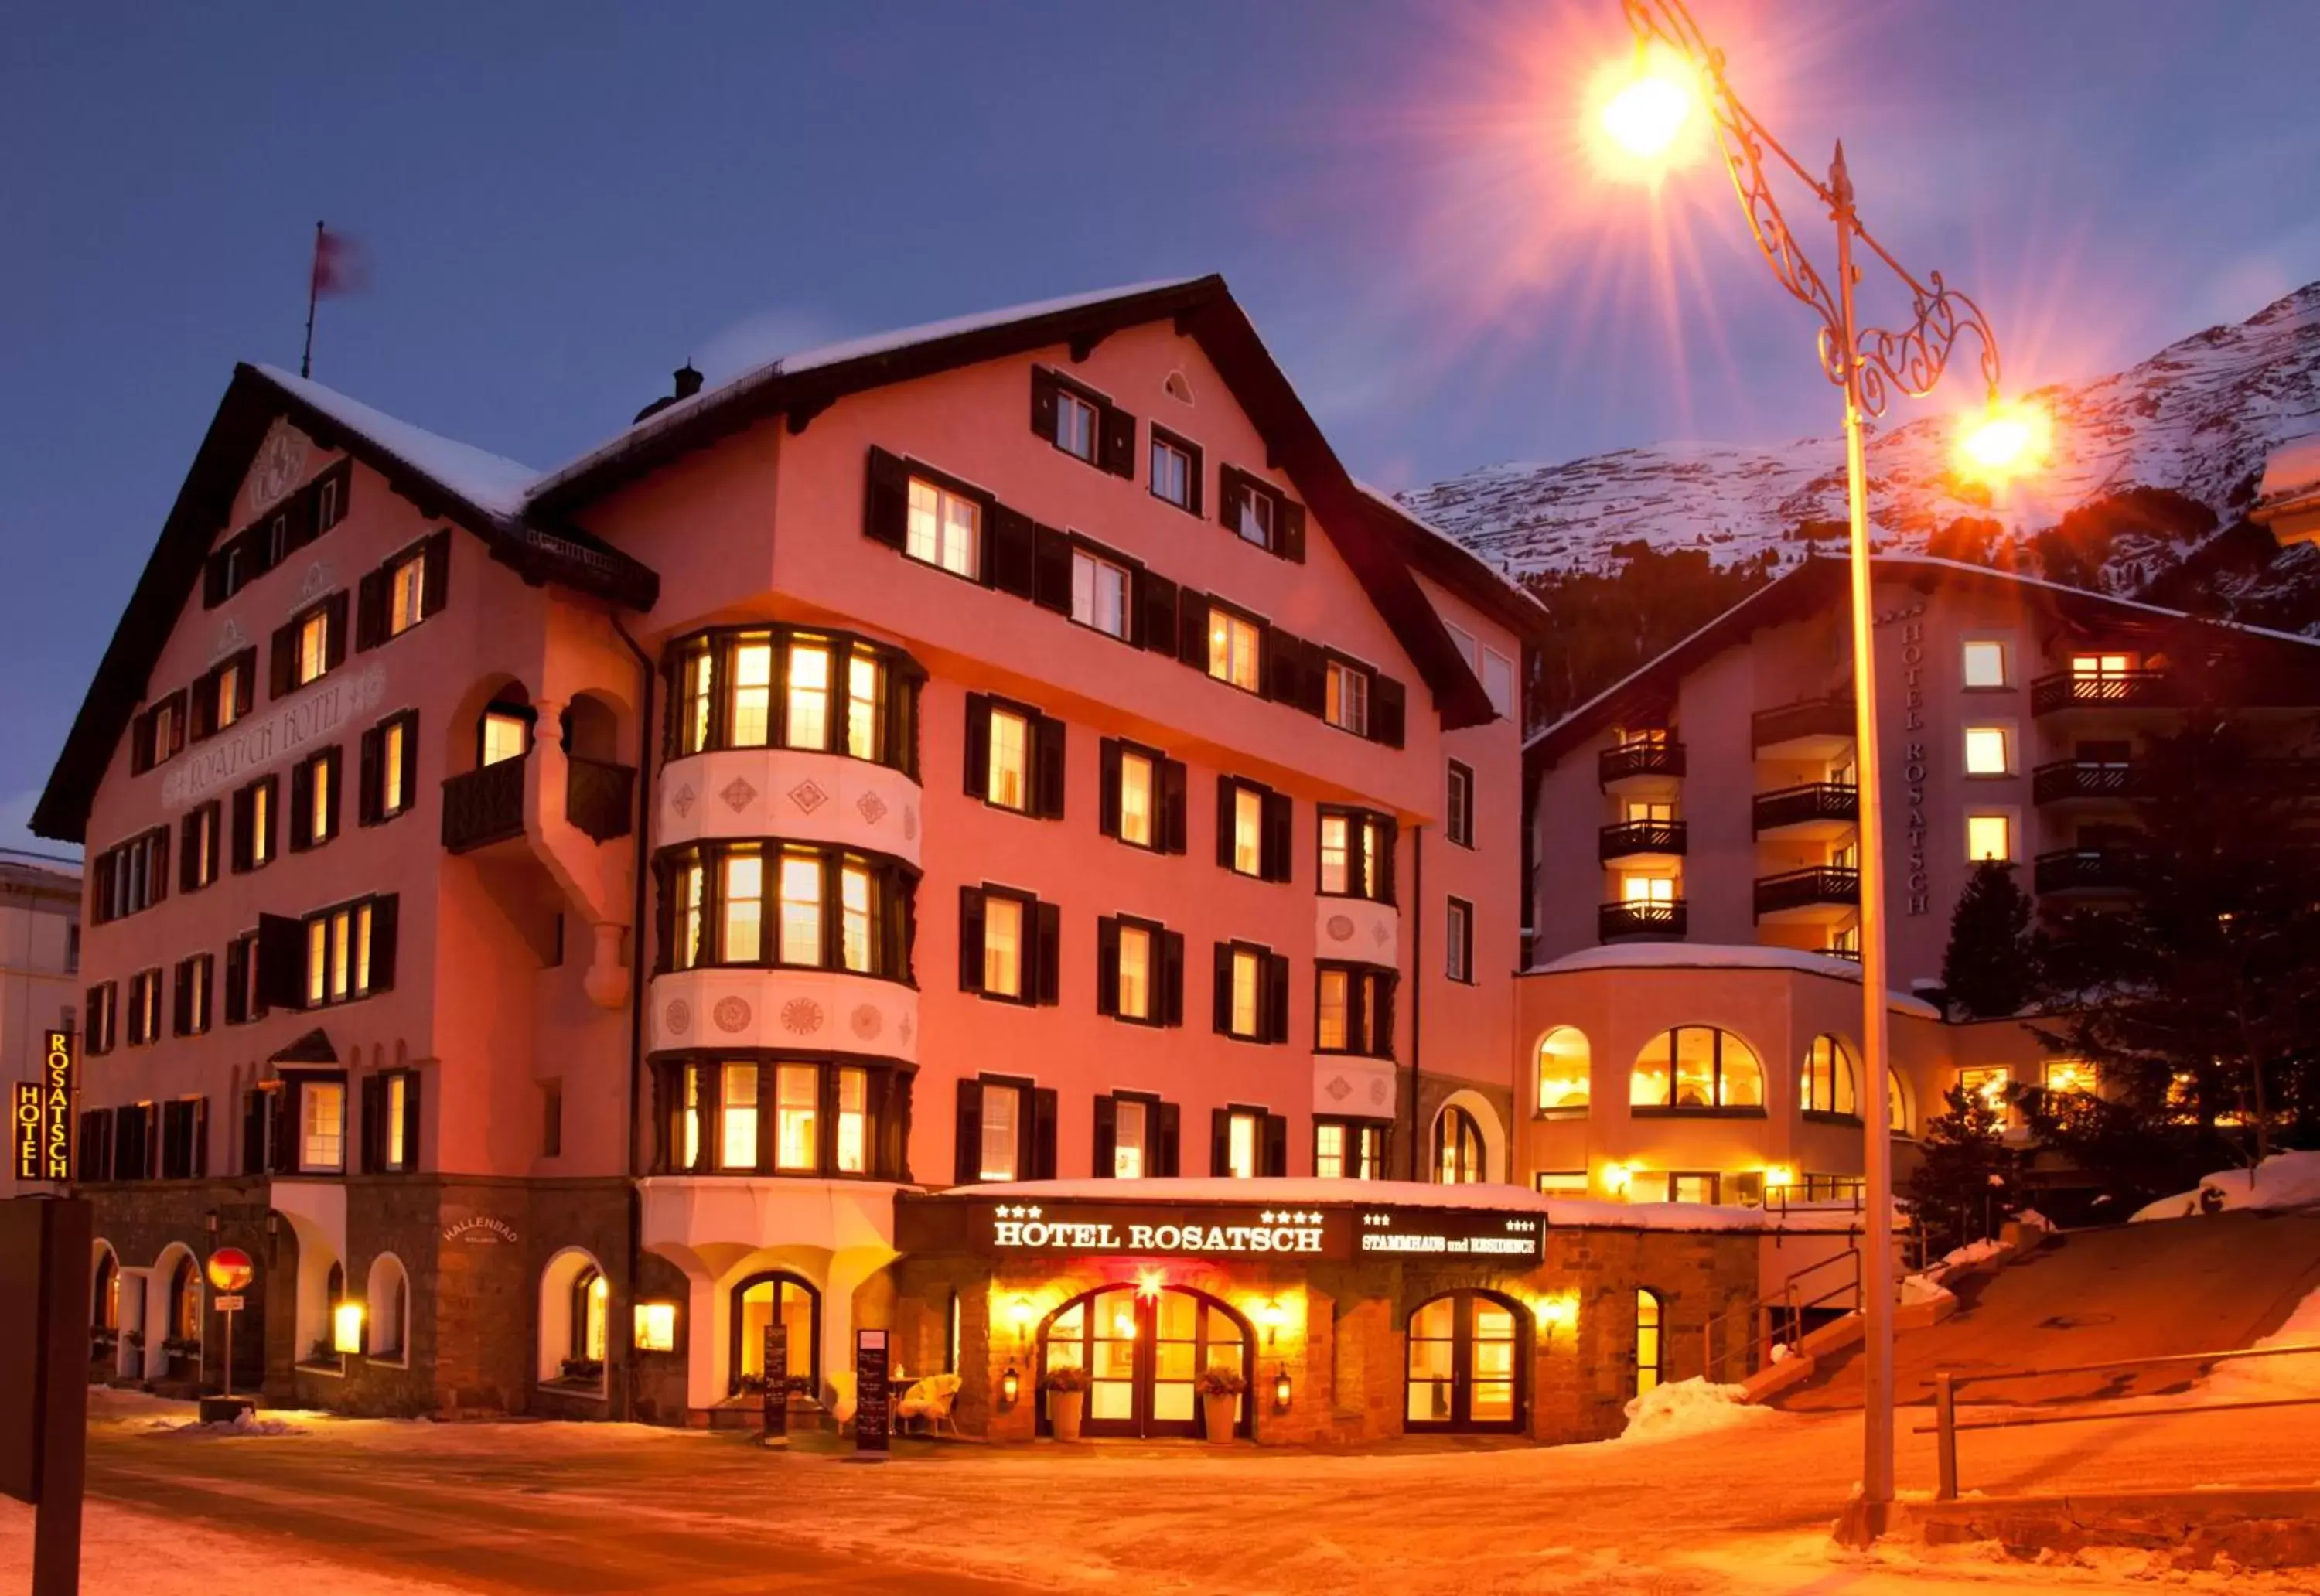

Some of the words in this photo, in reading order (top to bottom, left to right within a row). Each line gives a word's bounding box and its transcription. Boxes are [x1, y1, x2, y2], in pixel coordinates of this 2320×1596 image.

[1902, 623, 1924, 730] HOTEL
[1905, 742, 1928, 916] ROSATSCH
[19, 1086, 39, 1177] HOTEL
[48, 1034, 69, 1178] ROSATSCH
[443, 1216, 517, 1242] HALLENBAD
[995, 1222, 1121, 1248] HOTEL
[1128, 1225, 1323, 1252] ROSATSCH
[1447, 1238, 1468, 1252] und
